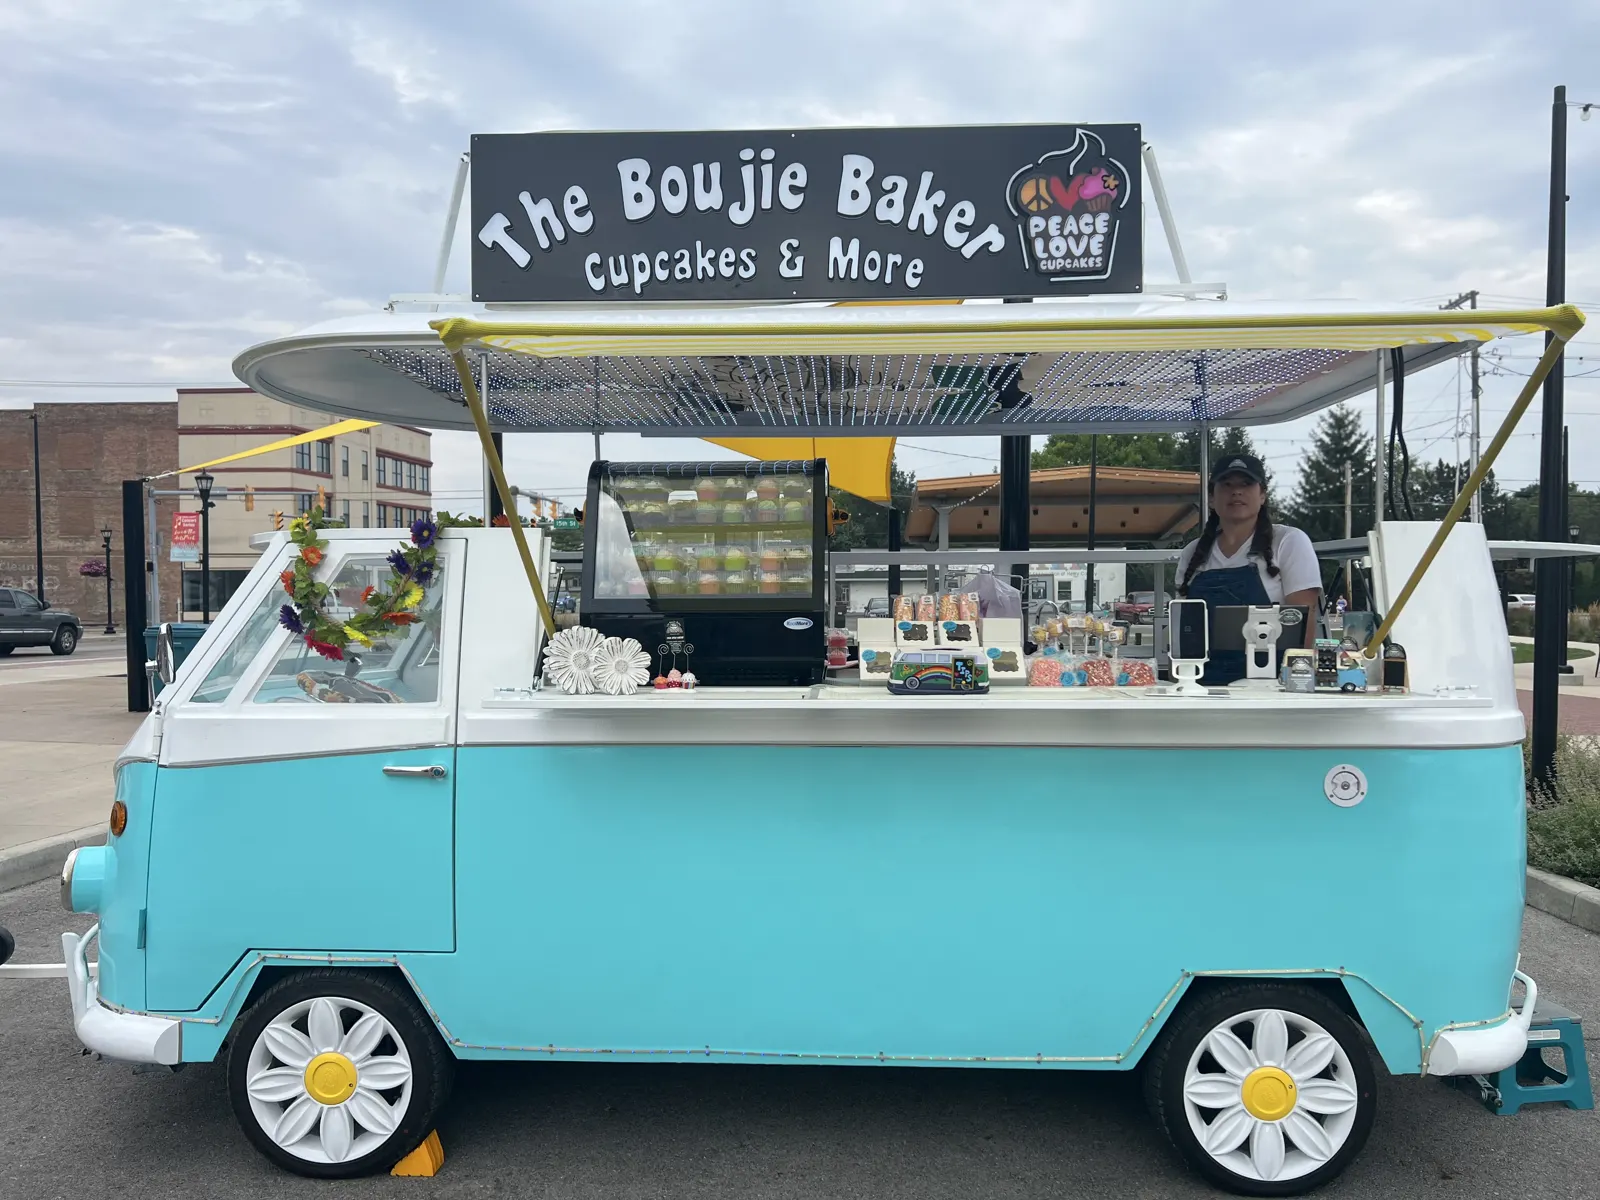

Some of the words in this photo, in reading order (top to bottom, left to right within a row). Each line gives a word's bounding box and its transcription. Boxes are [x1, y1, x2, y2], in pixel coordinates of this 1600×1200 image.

[478, 185, 594, 268] The
[617, 148, 808, 225] Boujie
[837, 154, 1005, 259] Baker
[1029, 212, 1110, 238] PEACE
[1034, 233, 1105, 259] LOVE
[584, 240, 756, 293] Cupcakes
[779, 238, 804, 278] &
[828, 236, 924, 288] More
[1040, 256, 1103, 270] CUPCAKES
[956, 661, 973, 683] TIPS
